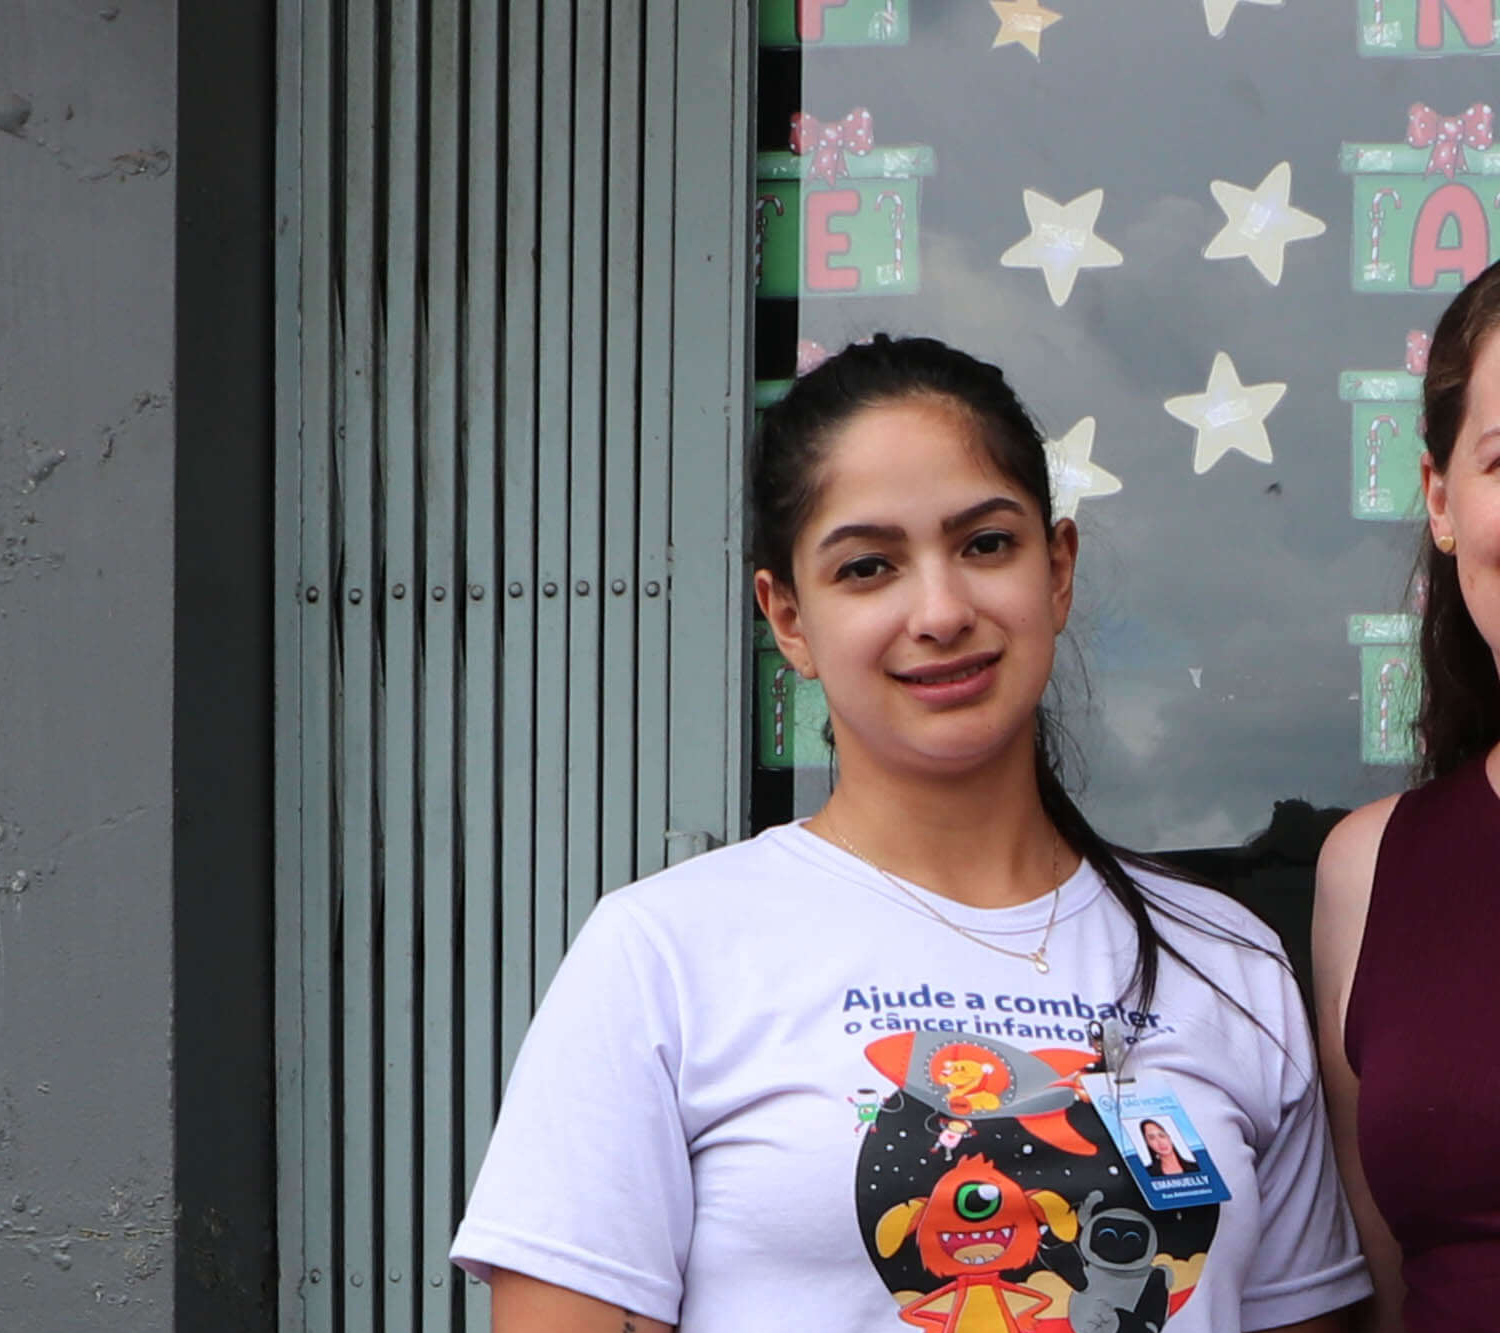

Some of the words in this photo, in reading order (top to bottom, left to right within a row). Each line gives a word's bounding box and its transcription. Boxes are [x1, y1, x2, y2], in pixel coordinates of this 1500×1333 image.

[842, 984, 956, 1014] Ajude
[965, 991, 986, 1009] a
[844, 1020, 863, 1035] o
[870, 1012, 967, 1033] câncer
